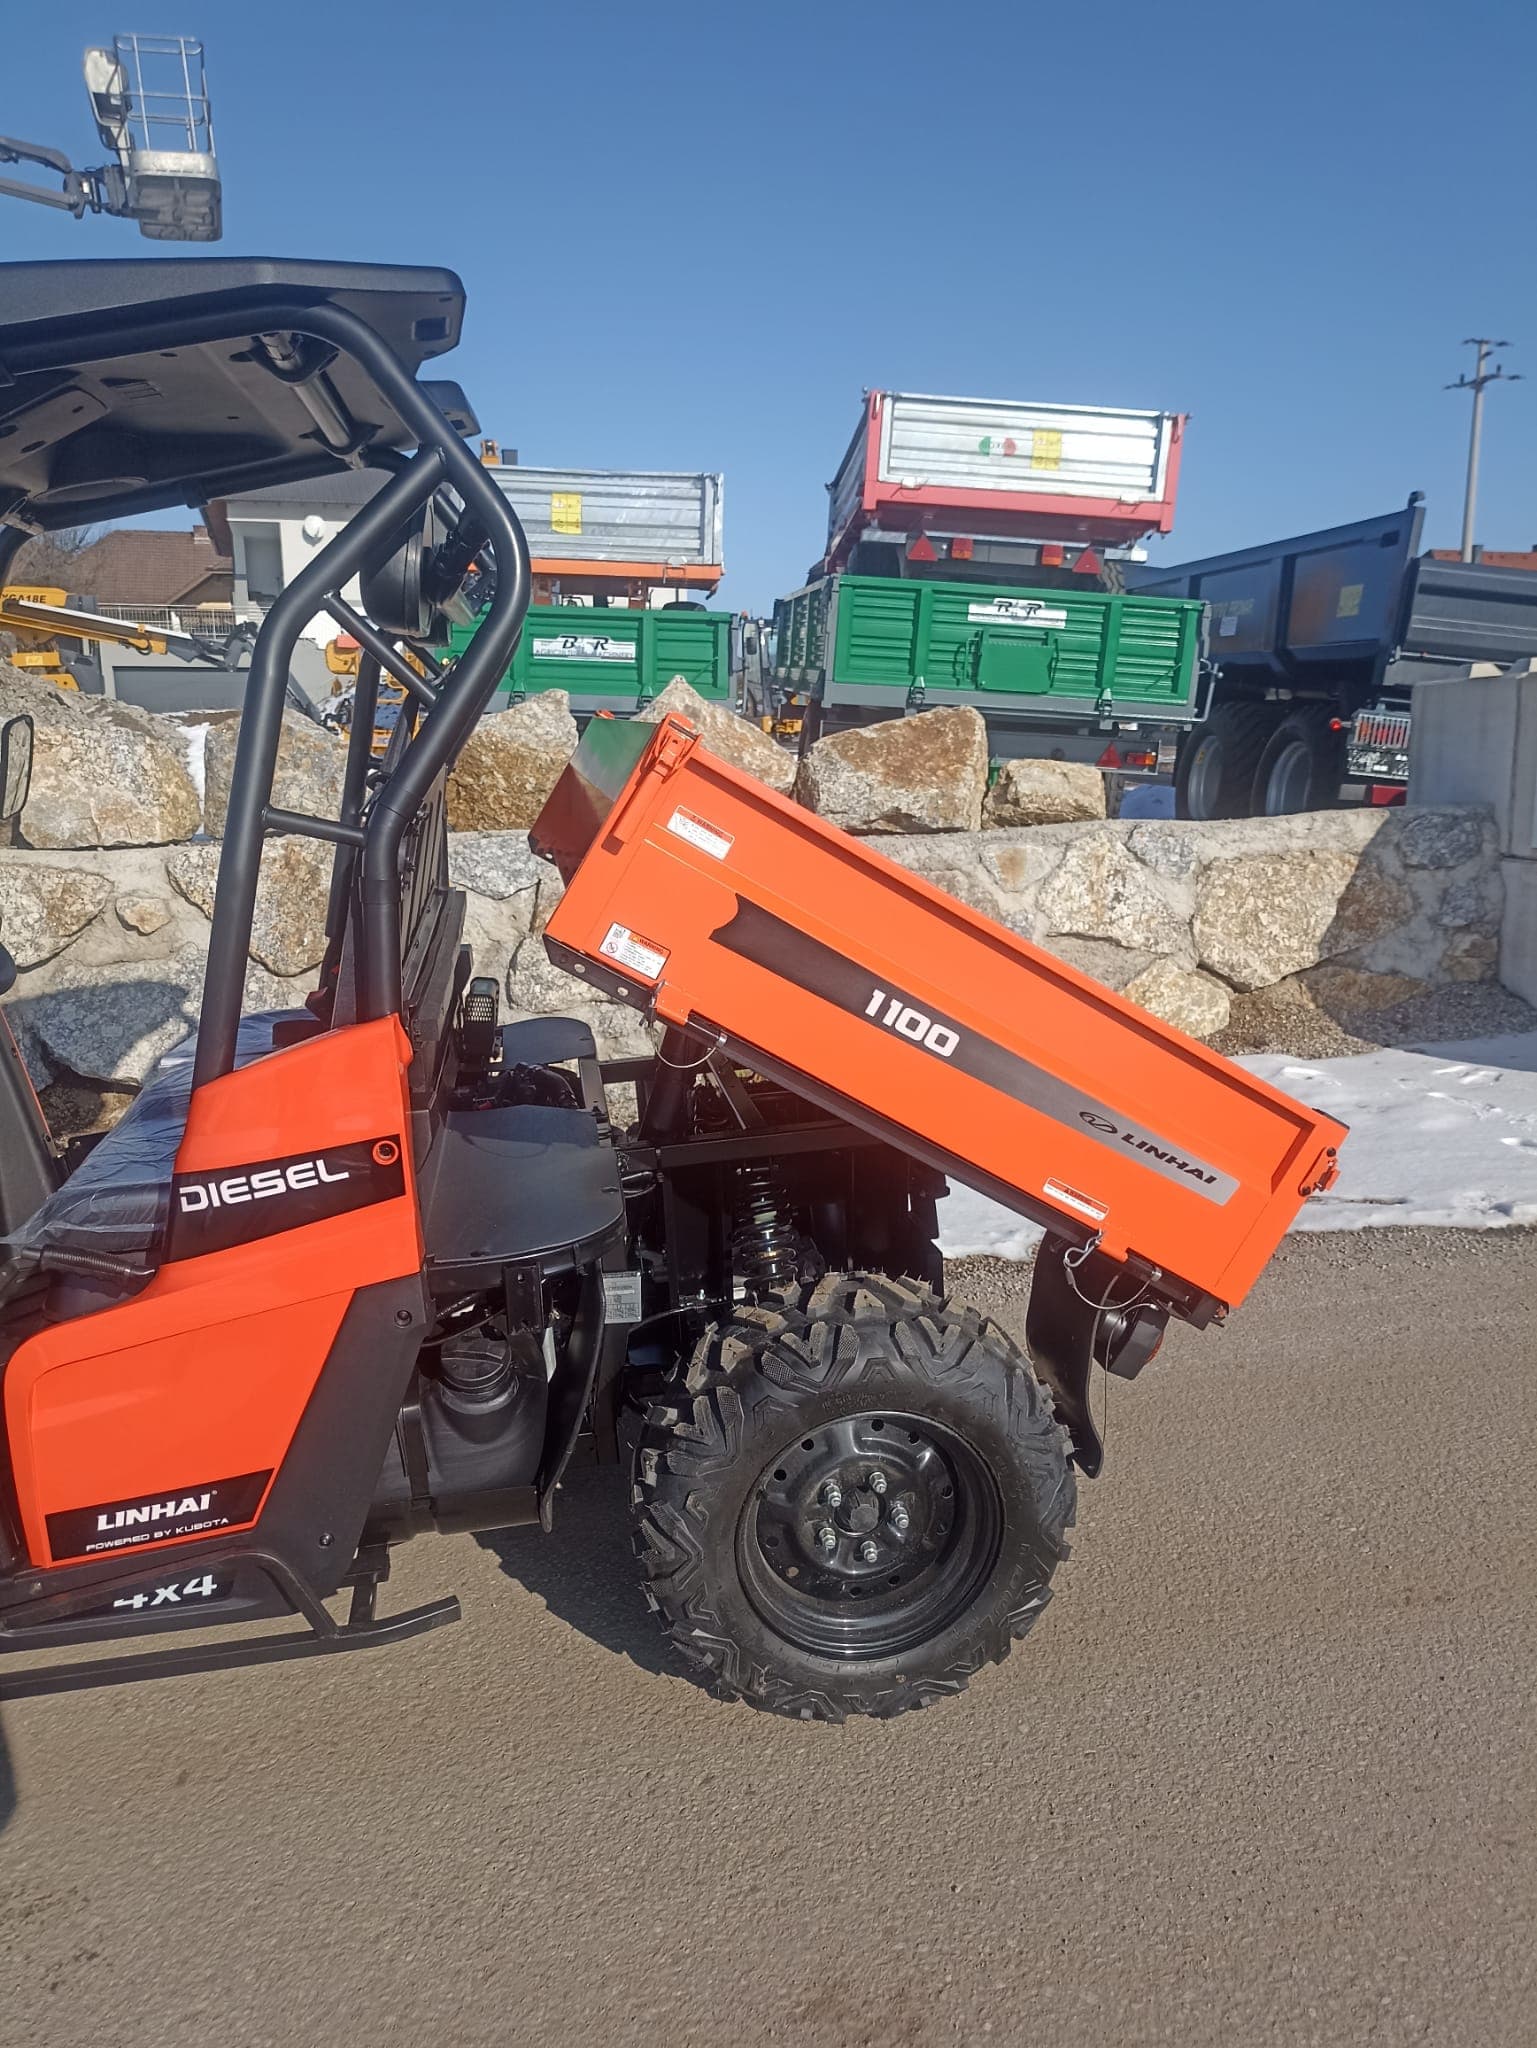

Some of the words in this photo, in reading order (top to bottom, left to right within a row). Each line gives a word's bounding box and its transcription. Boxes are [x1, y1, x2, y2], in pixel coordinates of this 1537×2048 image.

[865, 988, 960, 1057] 1100
[1121, 1133, 1217, 1184] LINHAI
[179, 1159, 350, 1213] DIESEL
[86, 1533, 150, 1552] POWERED
[154, 1529, 172, 1539] BY
[175, 1518, 229, 1534] KUBOTA
[97, 1493, 211, 1531] LINHAI
